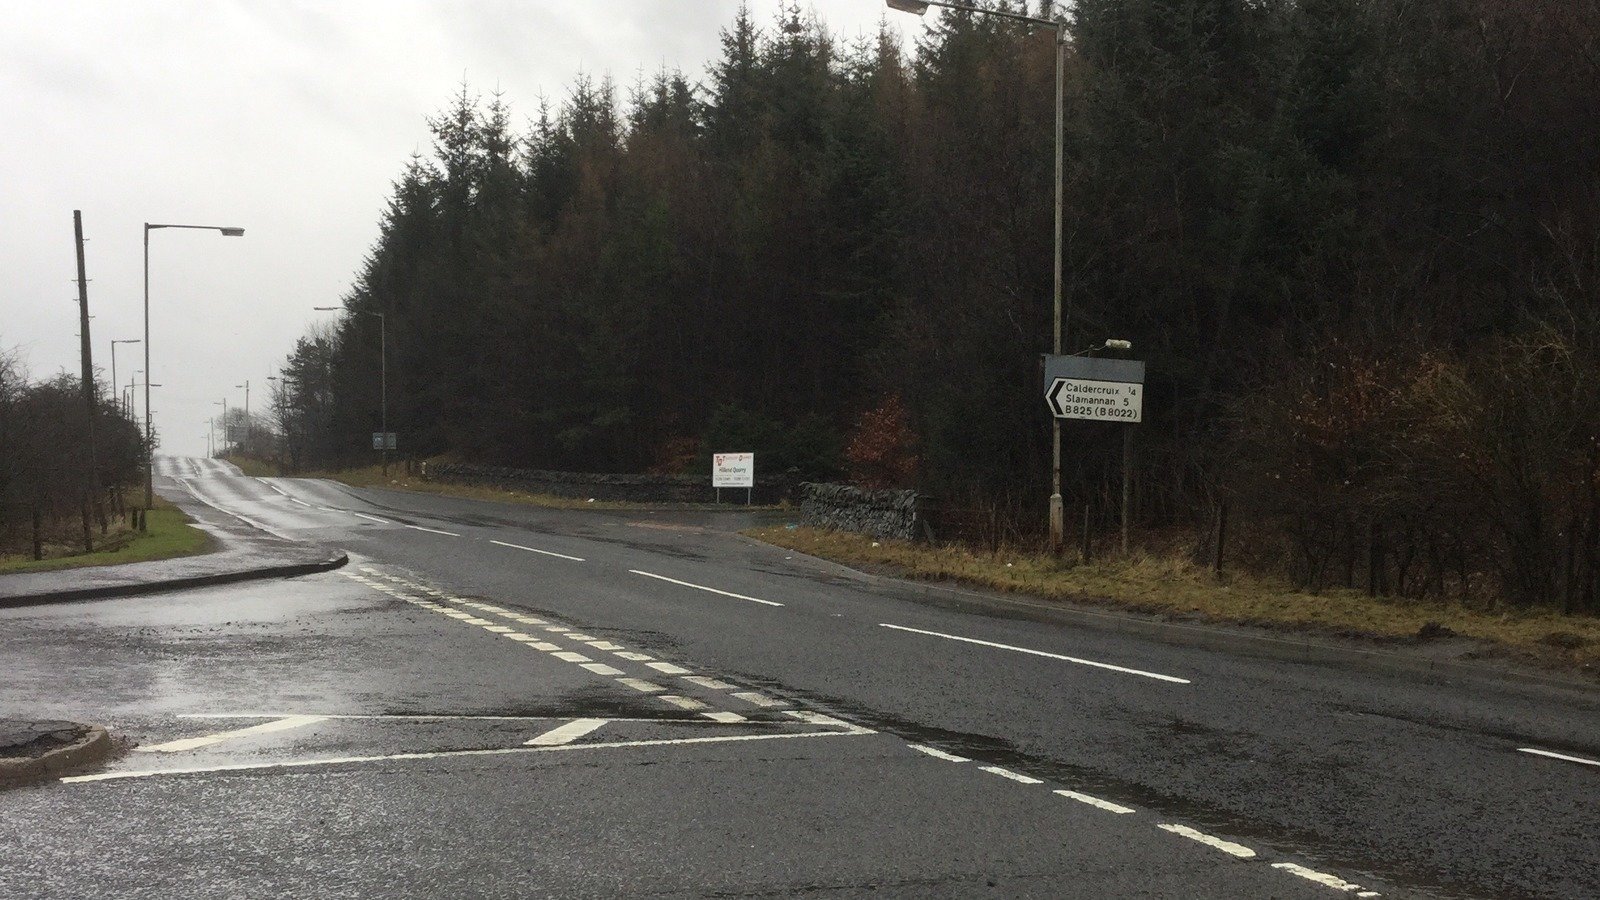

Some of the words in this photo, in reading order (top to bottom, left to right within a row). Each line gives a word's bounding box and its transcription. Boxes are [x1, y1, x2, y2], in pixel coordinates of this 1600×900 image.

[1066, 383, 1120, 395] Caldercruix
[1065, 394, 1116, 406] Slamannan
[1123, 398, 1129, 406] 5
